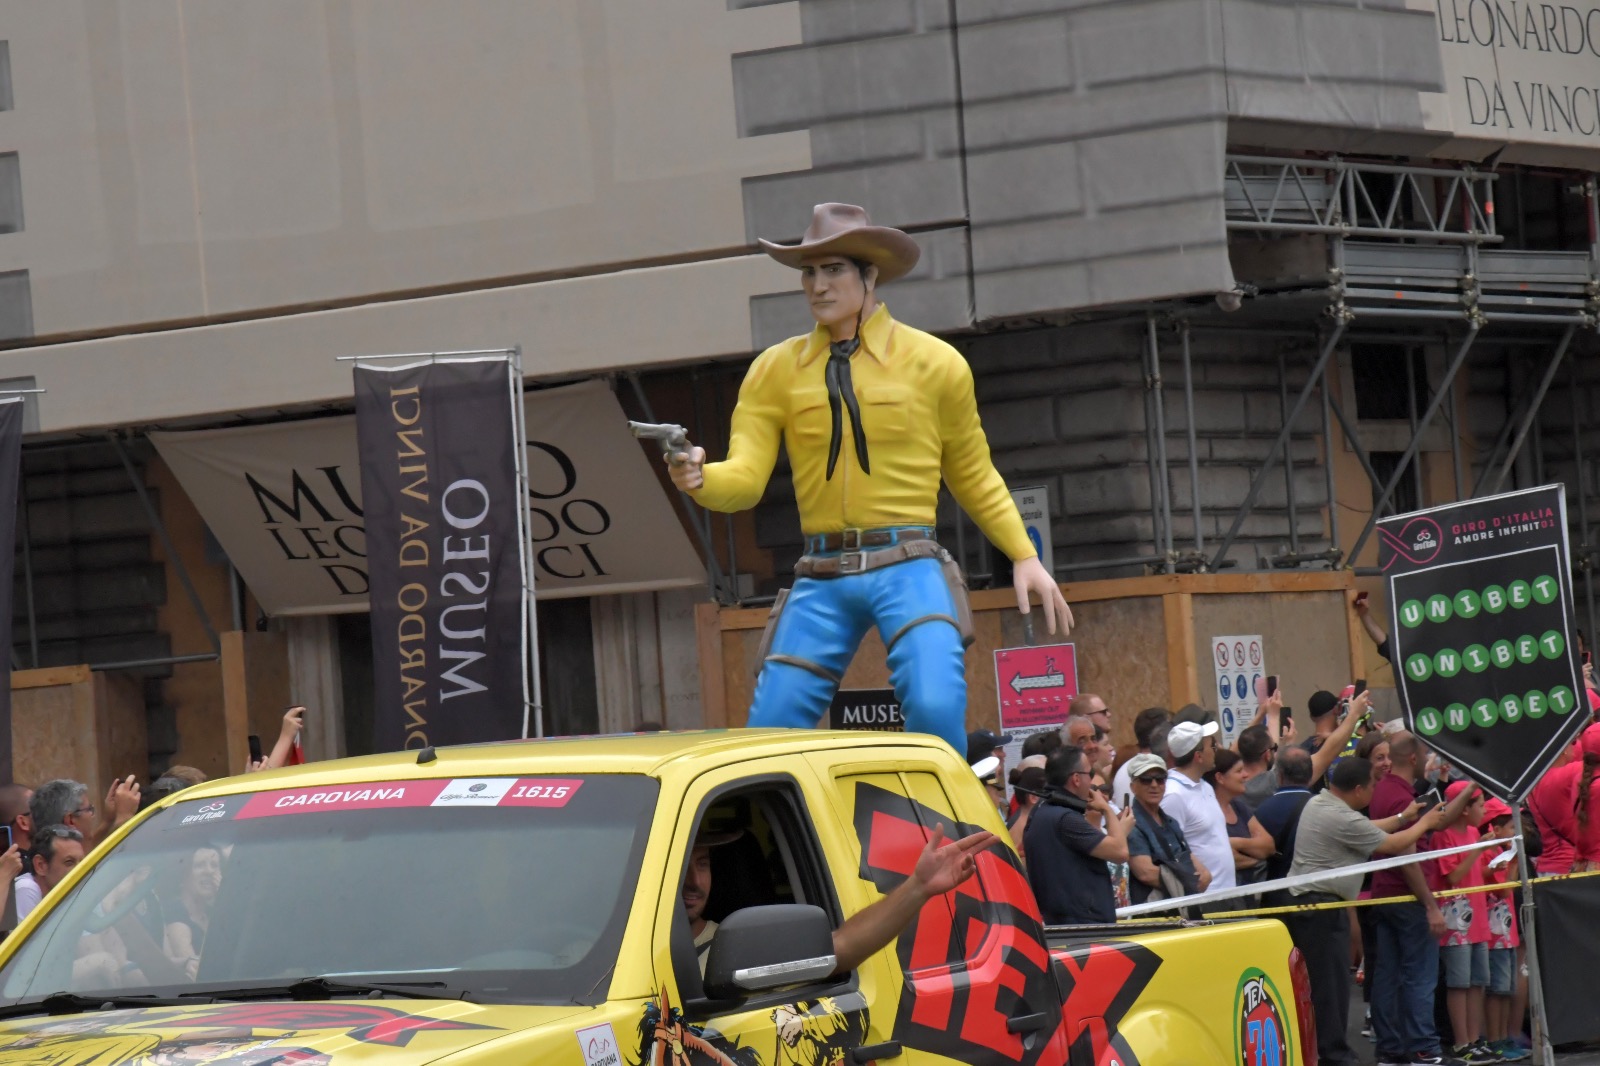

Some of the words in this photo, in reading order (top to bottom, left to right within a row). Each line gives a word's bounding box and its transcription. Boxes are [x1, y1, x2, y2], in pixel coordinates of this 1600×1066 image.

[1463, 76, 1514, 129] DA
[1020, 508, 1043, 521] edonale
[1452, 520, 1487, 535] GIRO
[1493, 507, 1554, 527] D'ITALIA
[1454, 530, 1495, 545] AMORE
[1405, 580, 1549, 622] UNIBET
[1410, 635, 1556, 677] UNIBET
[842, 704, 905, 724] MUSE
[1421, 690, 1565, 730] UNIBET
[275, 788, 405, 808] CAROVANA
[512, 786, 570, 798] 1615
[1243, 977, 1267, 1013] TEX
[1247, 1017, 1281, 1066] 70
